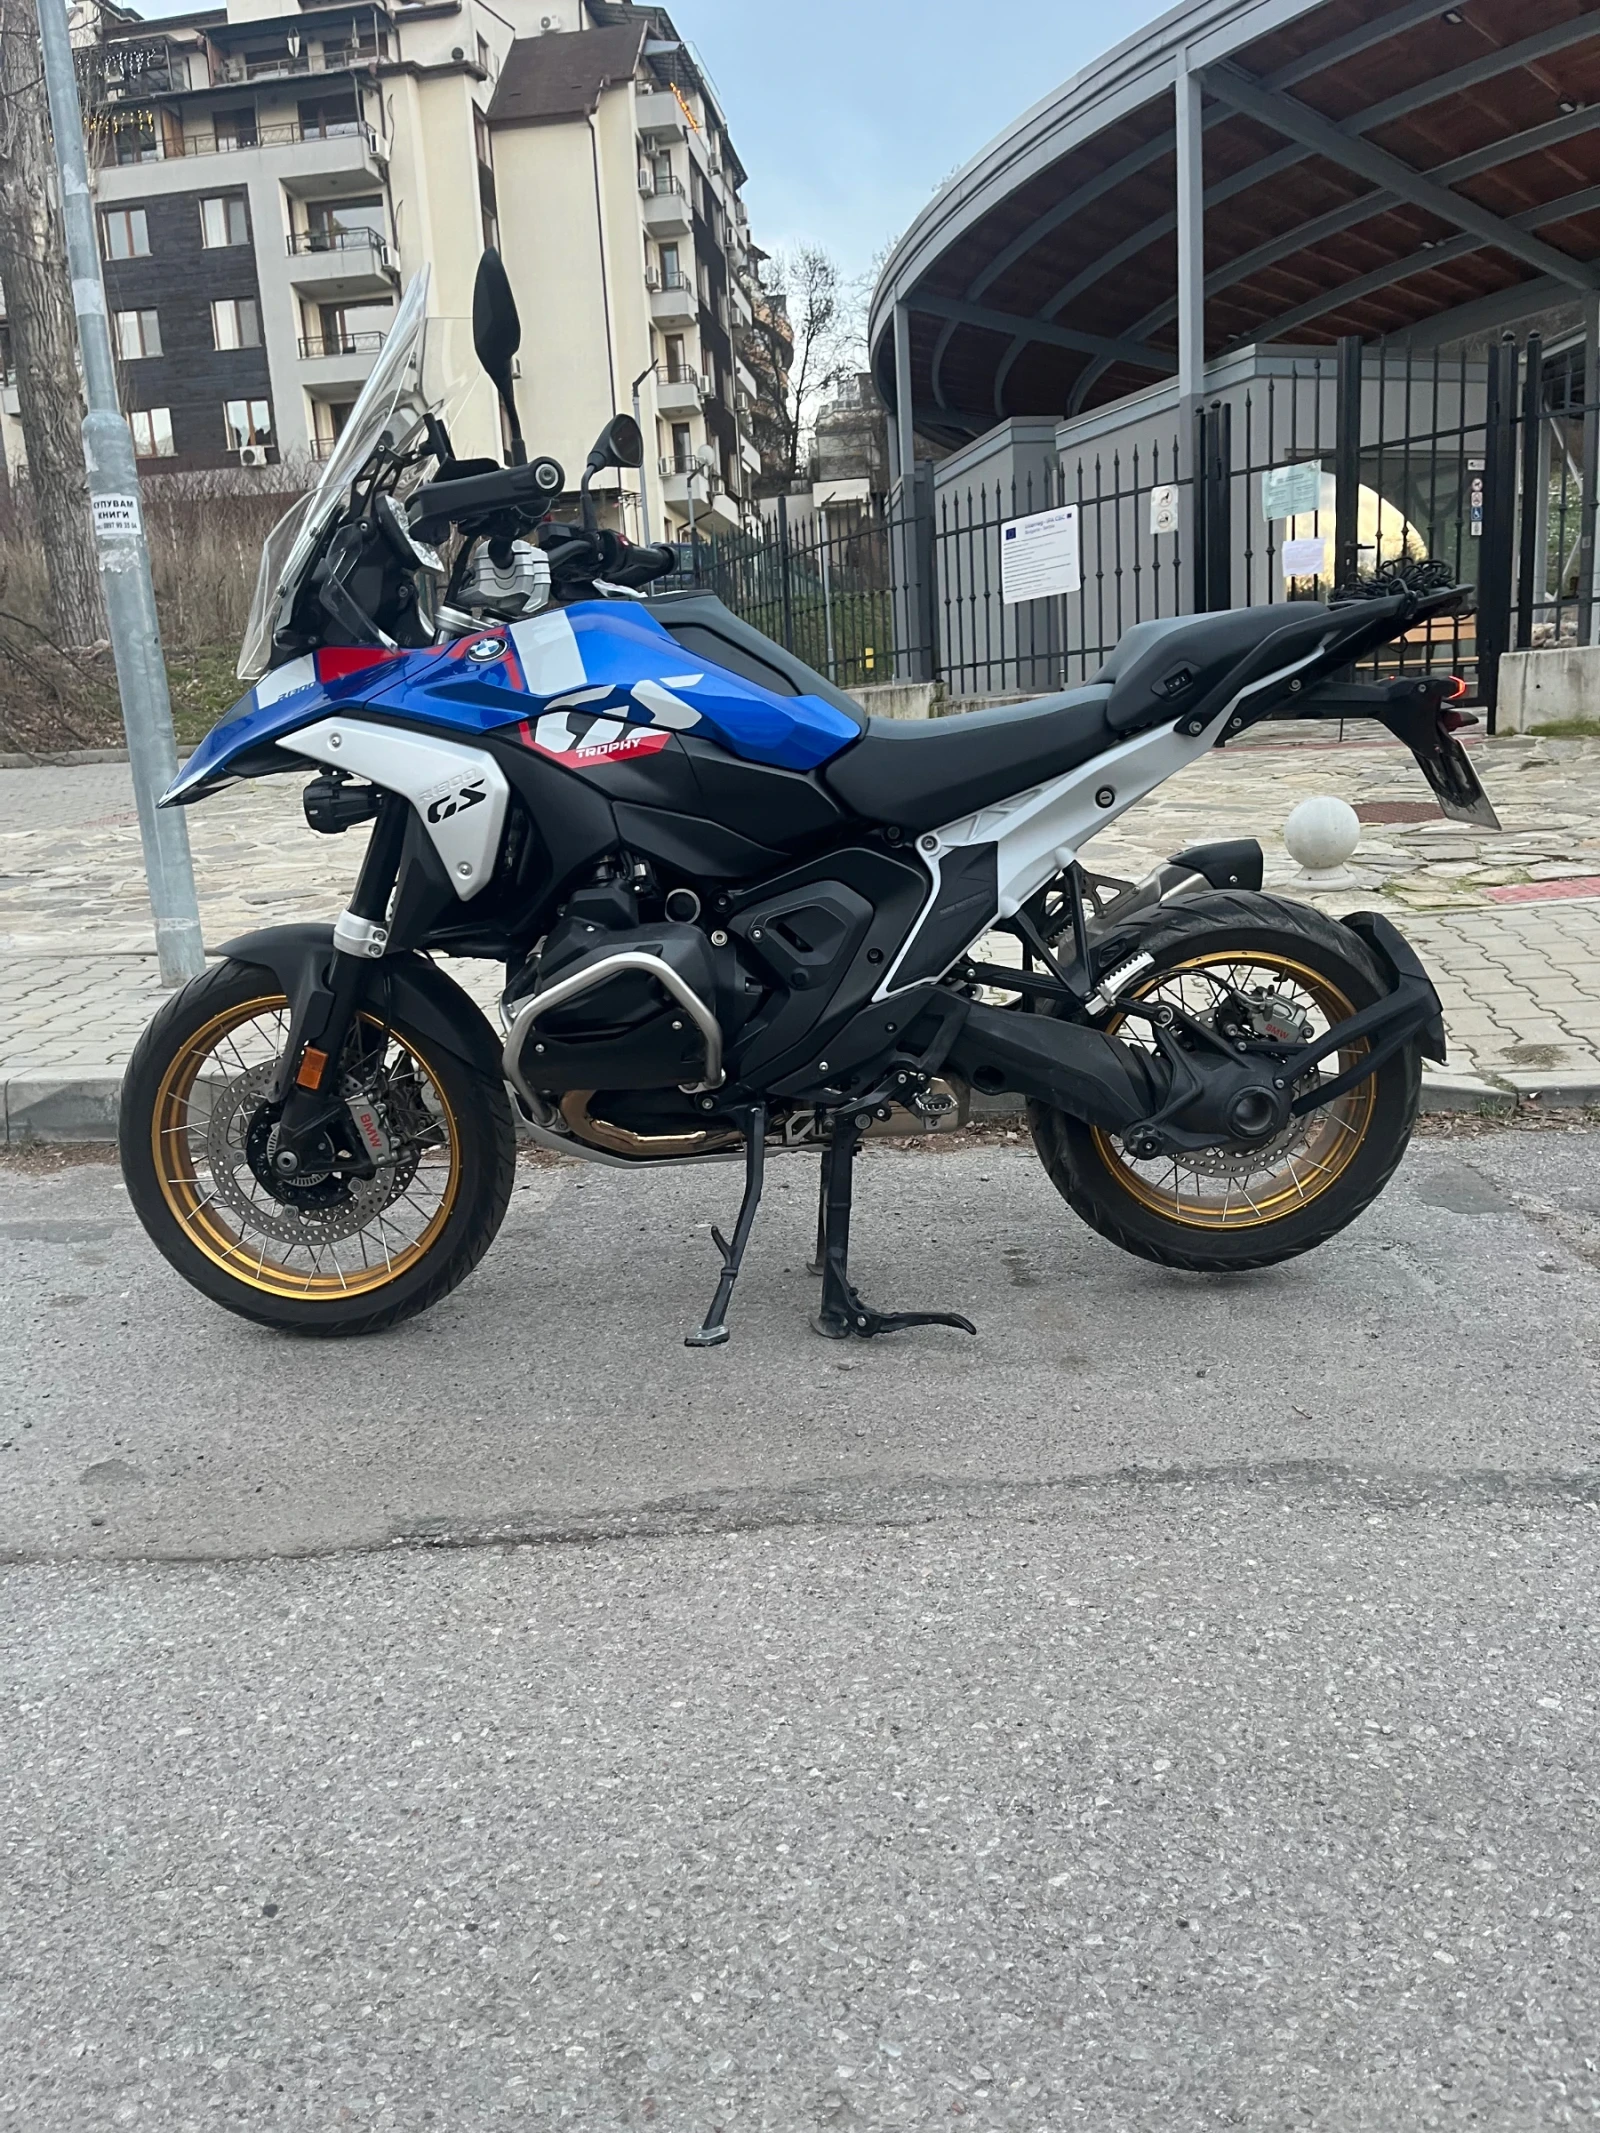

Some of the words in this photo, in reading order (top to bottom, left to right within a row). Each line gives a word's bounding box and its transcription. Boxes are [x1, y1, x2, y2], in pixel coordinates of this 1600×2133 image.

[98, 511, 129, 519] КНИГИ
[574, 738, 641, 759] TROPHY
[428, 778, 487, 823] GS
[1265, 1023, 1289, 1039] BMW
[360, 1113, 382, 1148] BMW
